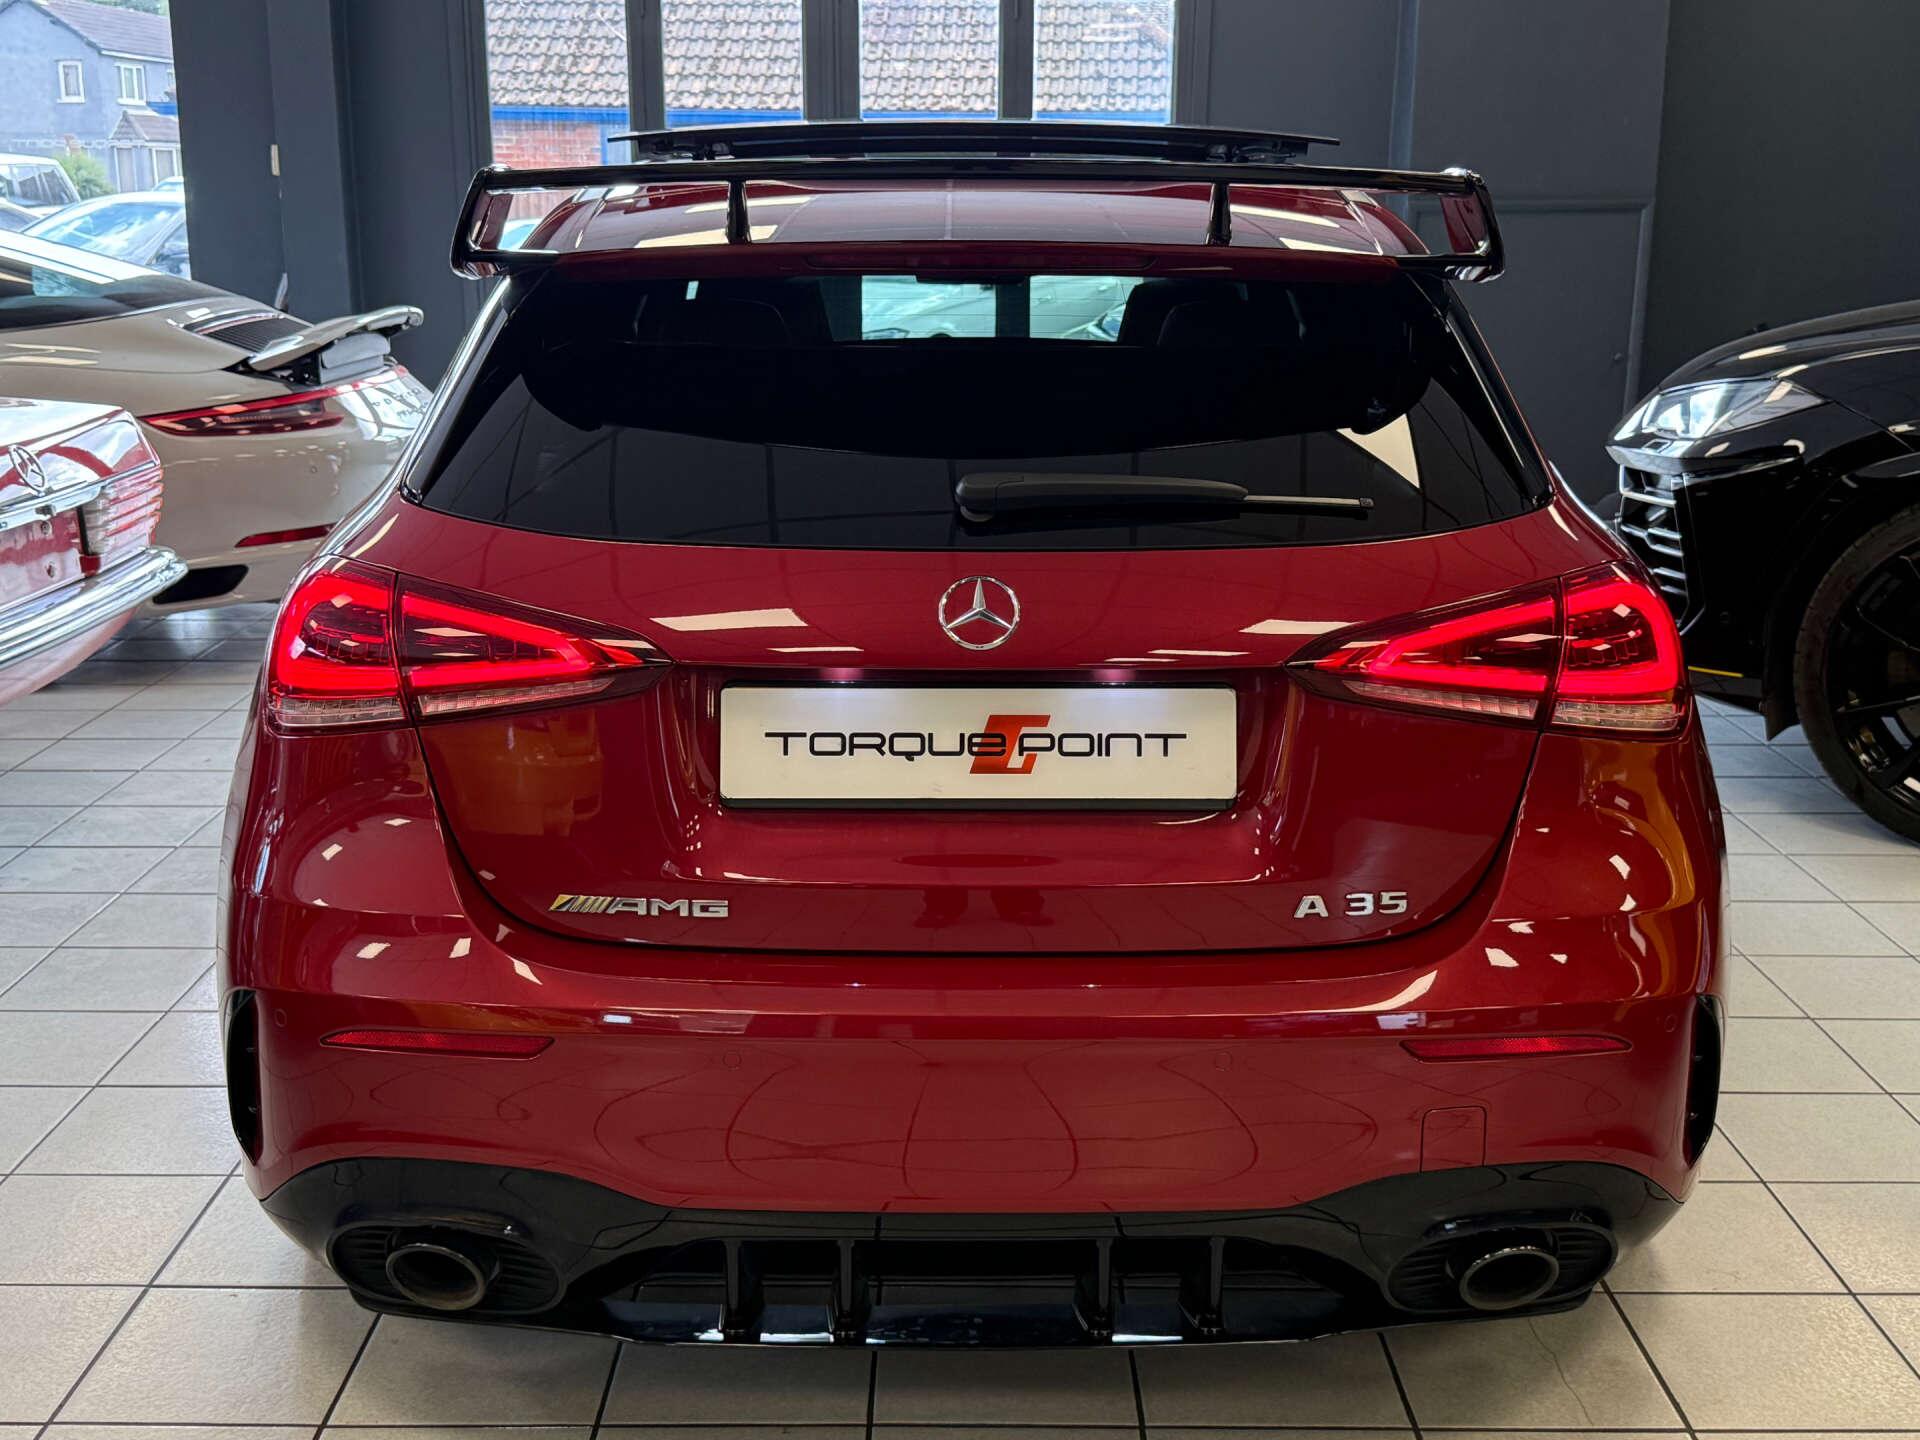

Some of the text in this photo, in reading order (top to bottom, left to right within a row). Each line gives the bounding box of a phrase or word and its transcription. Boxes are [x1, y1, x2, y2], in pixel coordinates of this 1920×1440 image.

[1017, 732, 1188, 758] POINT
[605, 897, 729, 918] AMG
[1293, 891, 1408, 918] A 35
